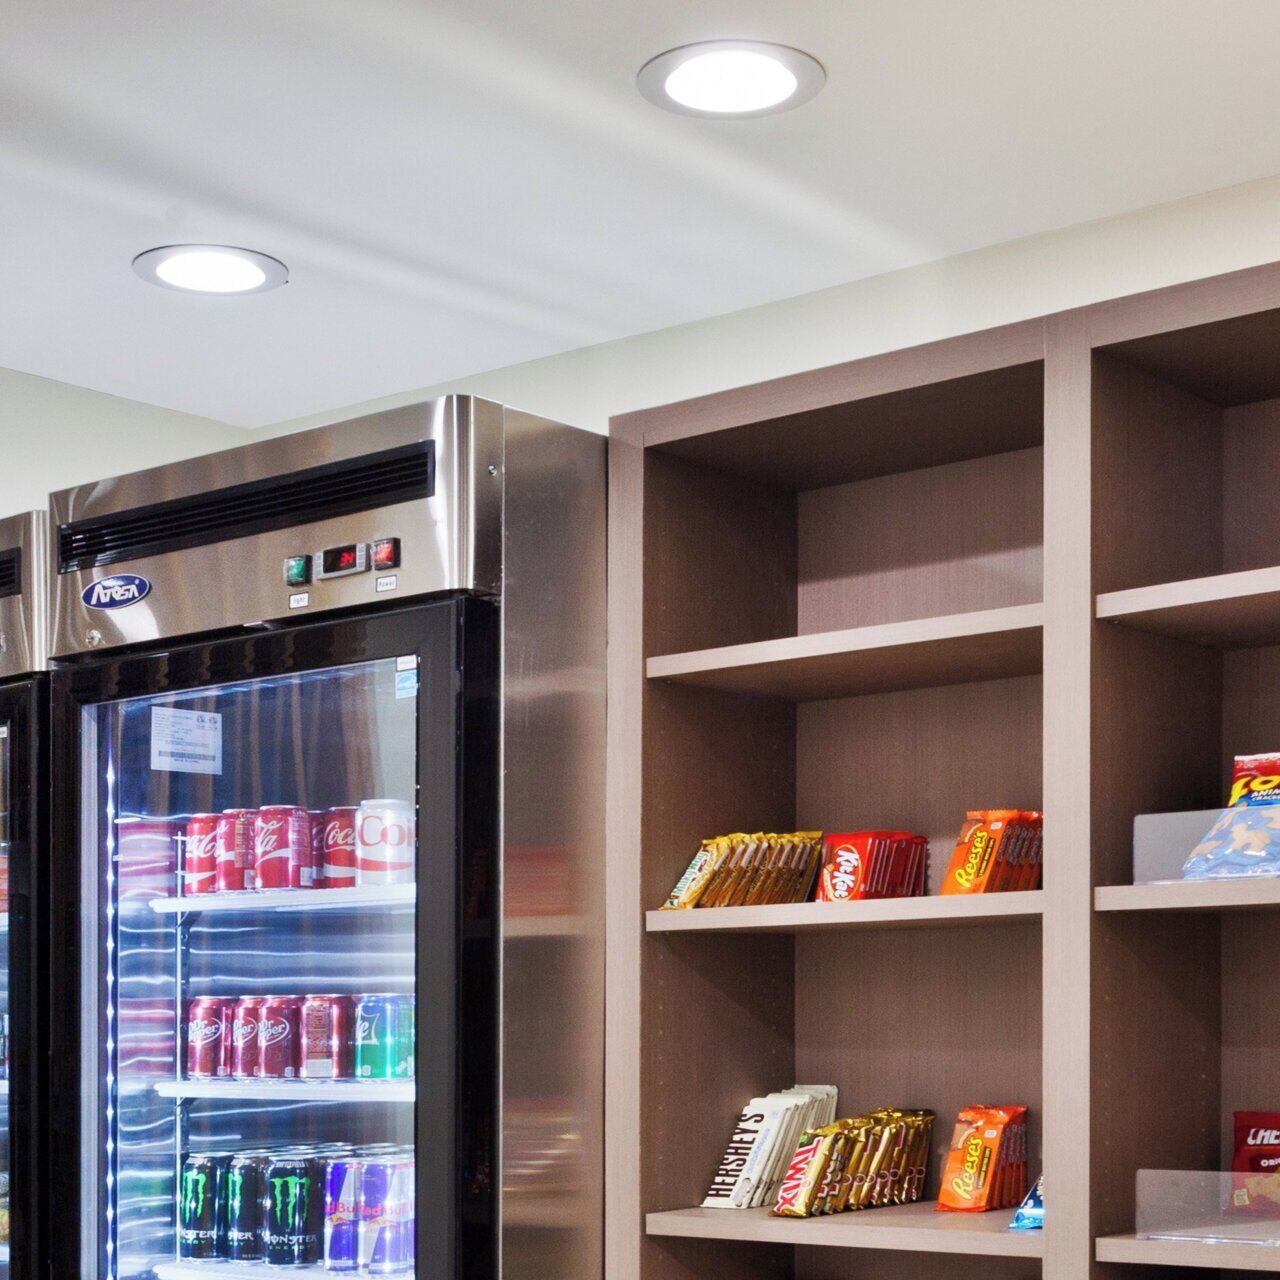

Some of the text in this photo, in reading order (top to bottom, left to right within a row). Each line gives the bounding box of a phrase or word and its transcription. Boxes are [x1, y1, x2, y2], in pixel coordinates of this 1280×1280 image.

[955, 830, 989, 888] Reese's
[707, 1113, 765, 1198] HERSHEY'S
[774, 1136, 824, 1213] TWIX
[952, 1137, 983, 1200] Reese's
